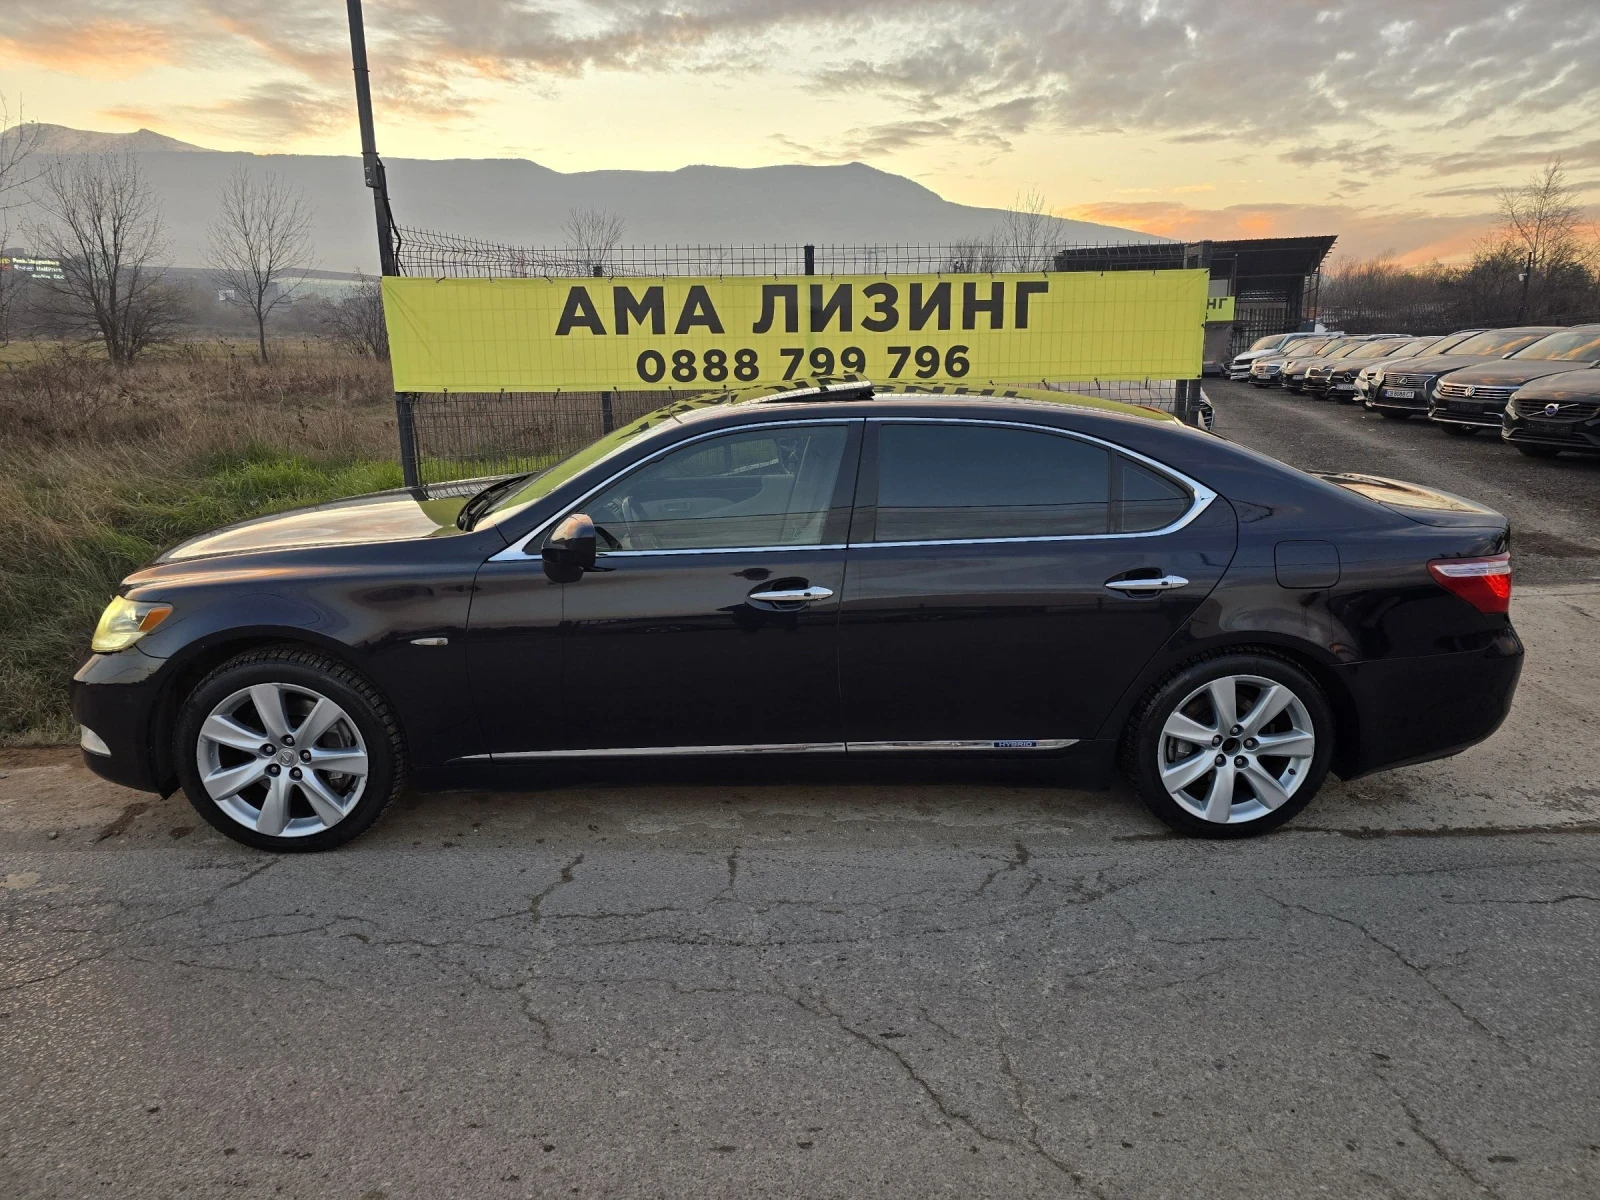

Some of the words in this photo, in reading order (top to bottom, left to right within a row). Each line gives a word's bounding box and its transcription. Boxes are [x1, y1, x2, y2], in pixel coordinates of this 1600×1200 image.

[555, 285, 726, 336] АМА
[752, 281, 1049, 335] ЛИЗИНГ
[636, 348, 760, 383] 0888
[780, 346, 866, 380] 799
[887, 344, 970, 379] 796
